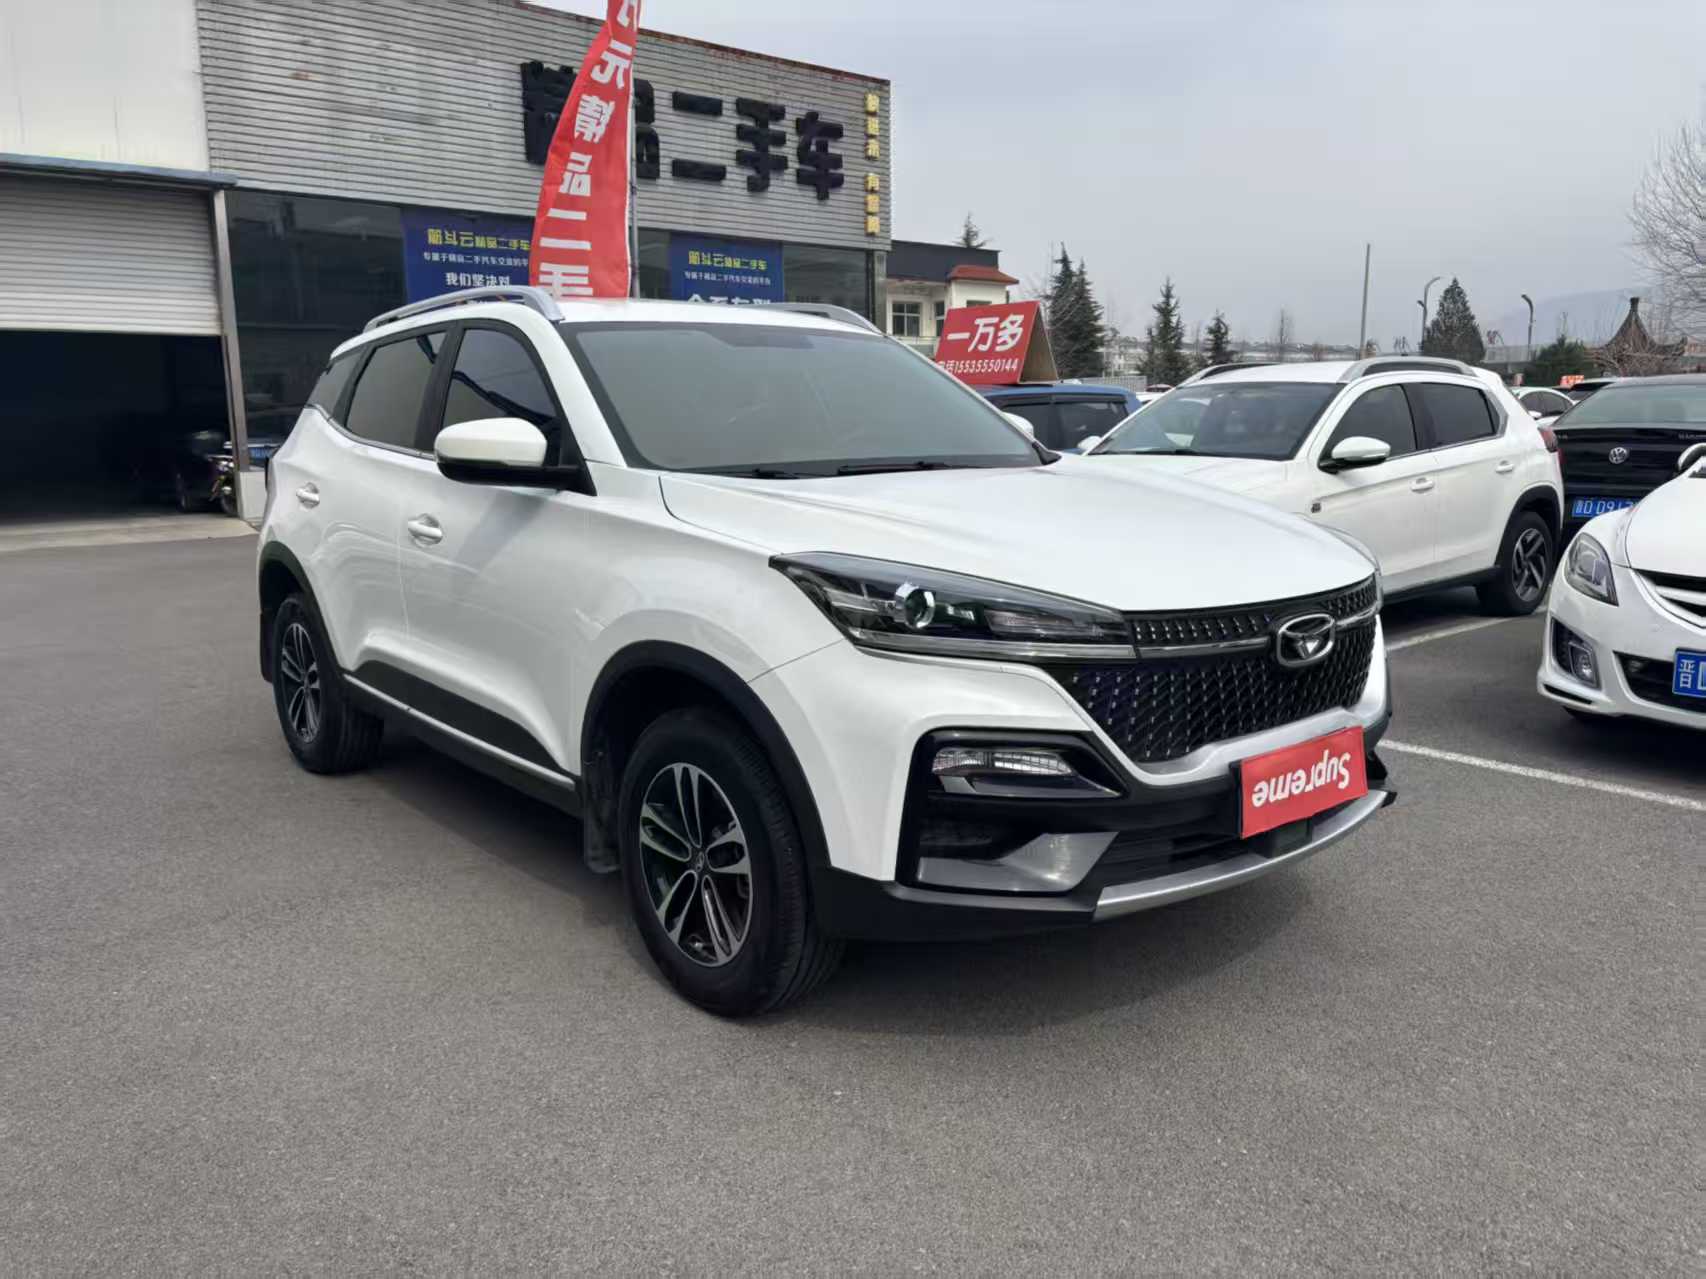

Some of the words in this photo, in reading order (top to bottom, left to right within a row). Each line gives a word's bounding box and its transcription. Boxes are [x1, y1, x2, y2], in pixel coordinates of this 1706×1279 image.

[521, 60, 844, 201] 二手车
[947, 314, 1024, 352] 一万多
[1252, 749, 1351, 807] Supreme
